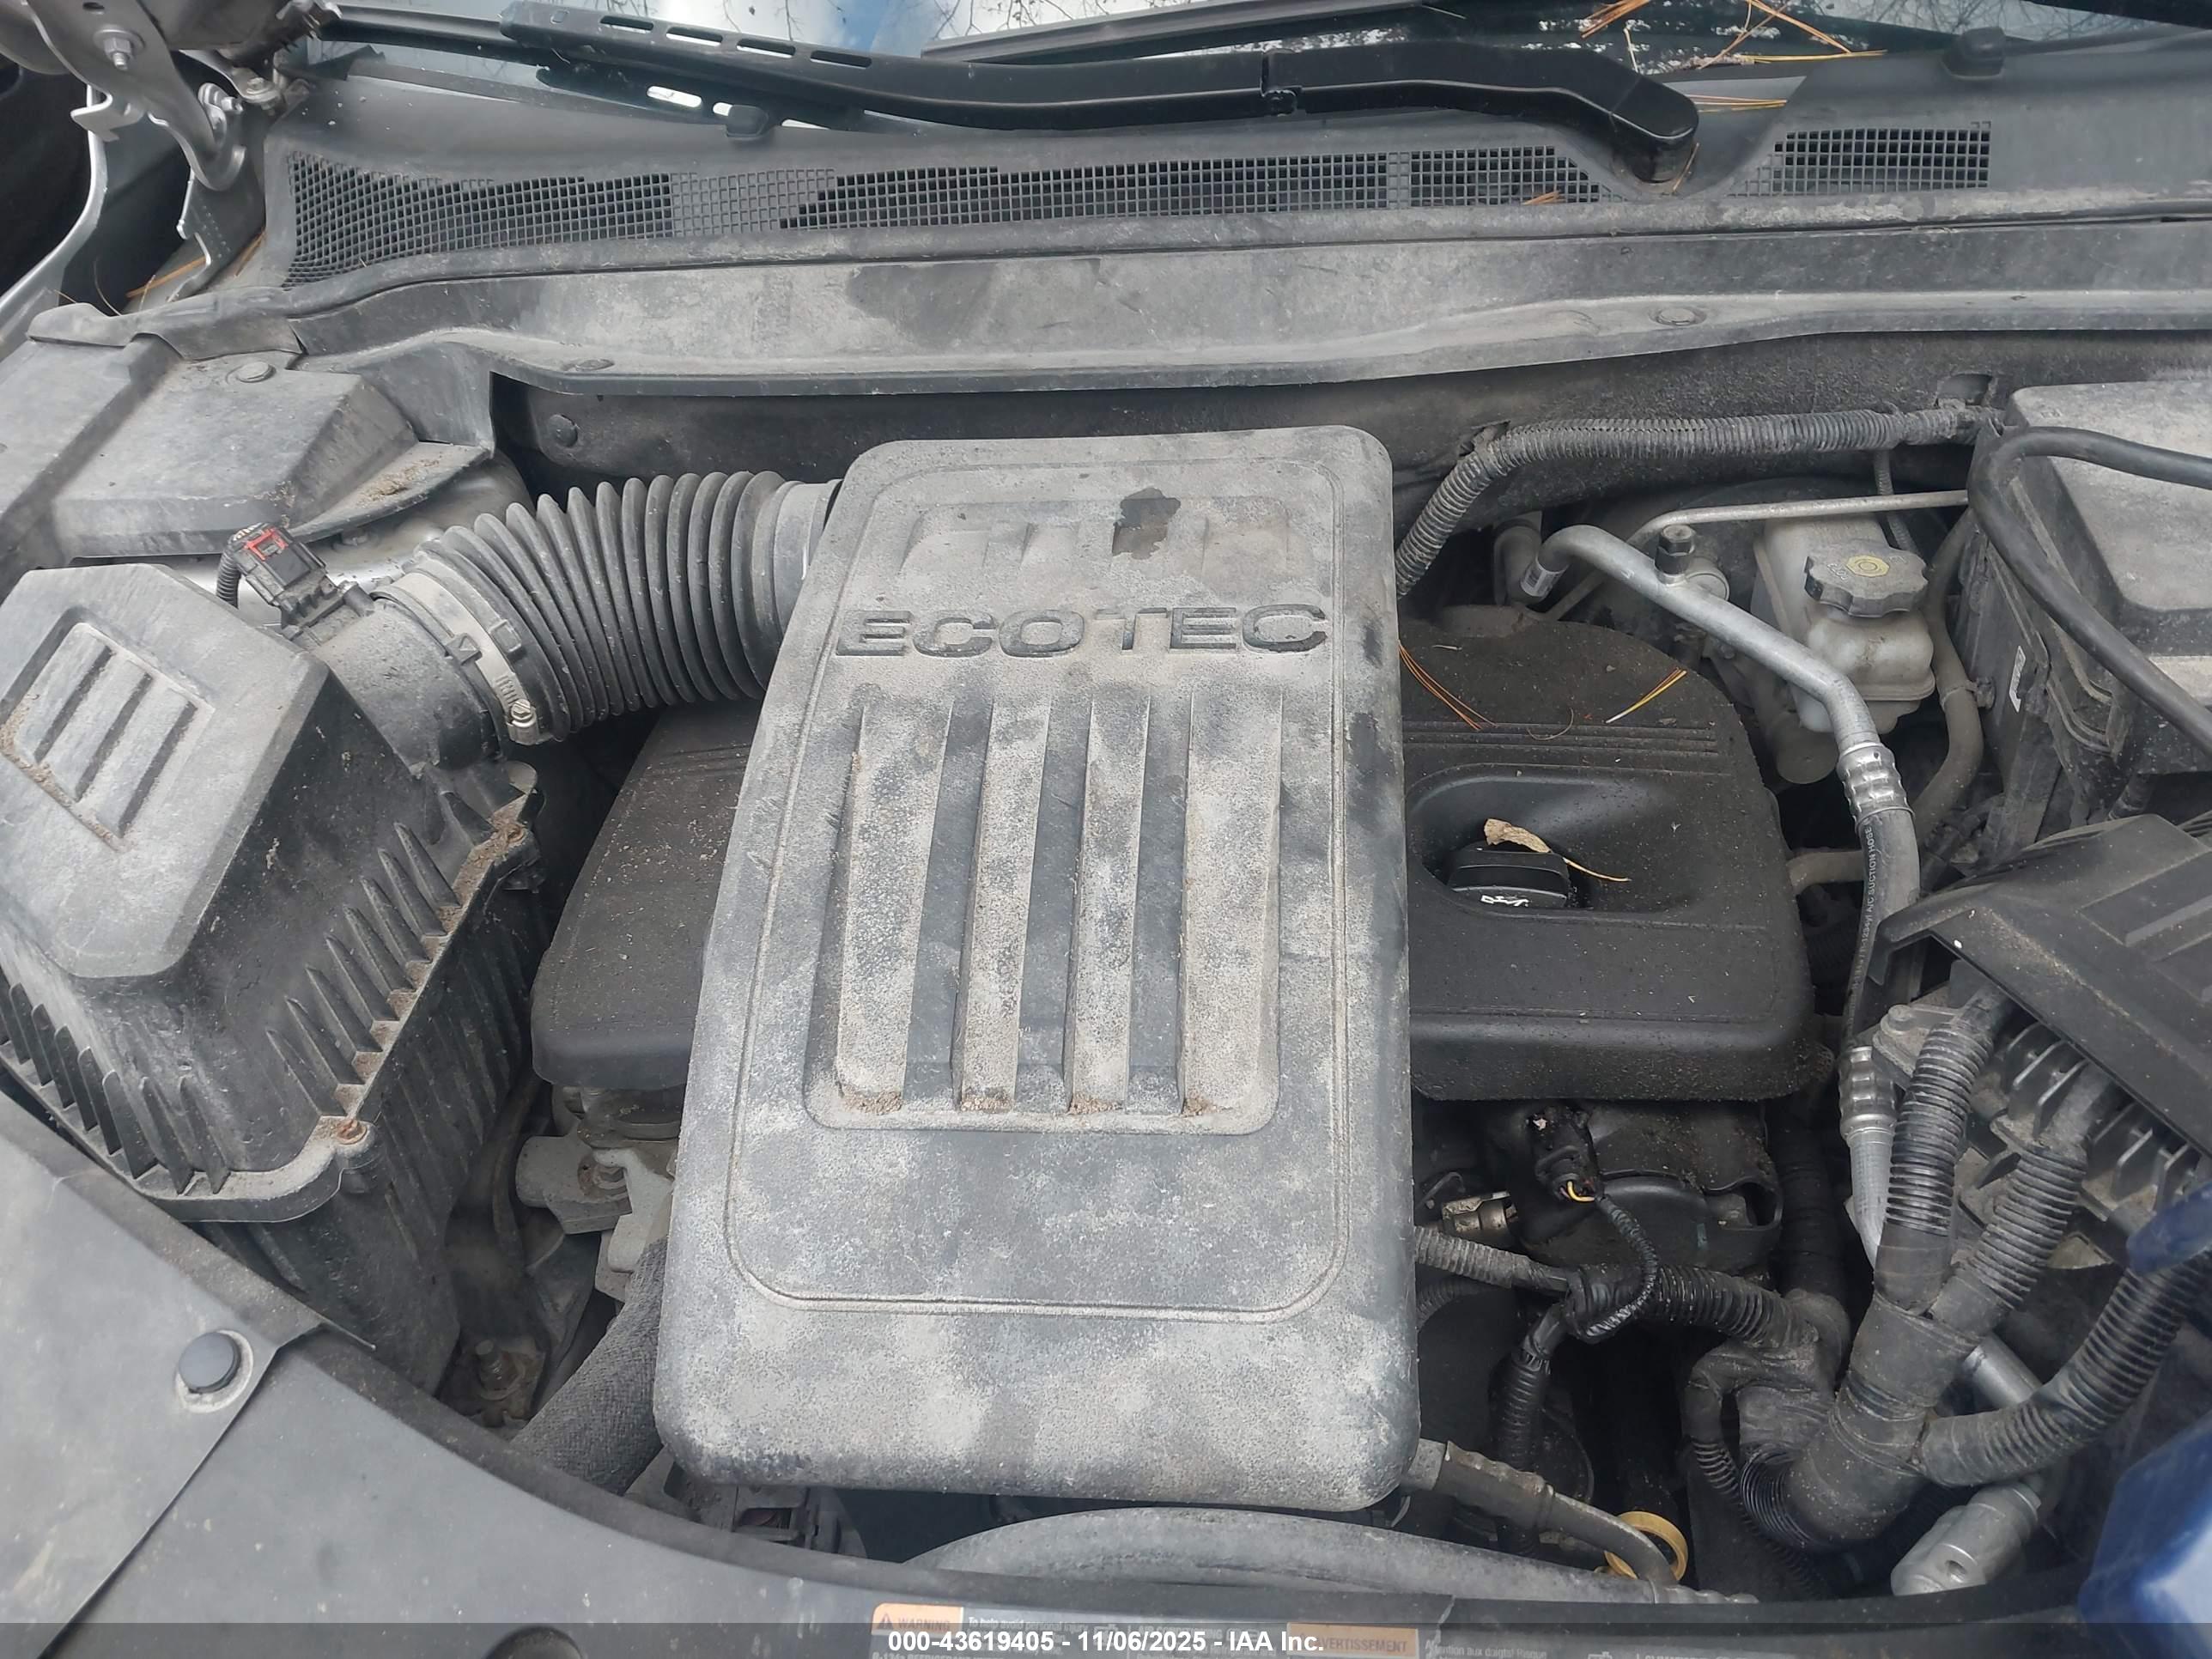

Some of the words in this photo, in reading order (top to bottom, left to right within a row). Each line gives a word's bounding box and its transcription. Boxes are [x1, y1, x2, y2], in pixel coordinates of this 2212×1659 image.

[835, 603, 1329, 658] ECOTEC
[1864, 826, 1875, 852] HOSE
[1868, 854, 1876, 895] SUCTION
[1866, 897, 1875, 912] A/C
[897, 1617, 950, 1632] WARNING
[968, 1616, 978, 1627] To
[1000, 1619, 1024, 1629] avoid
